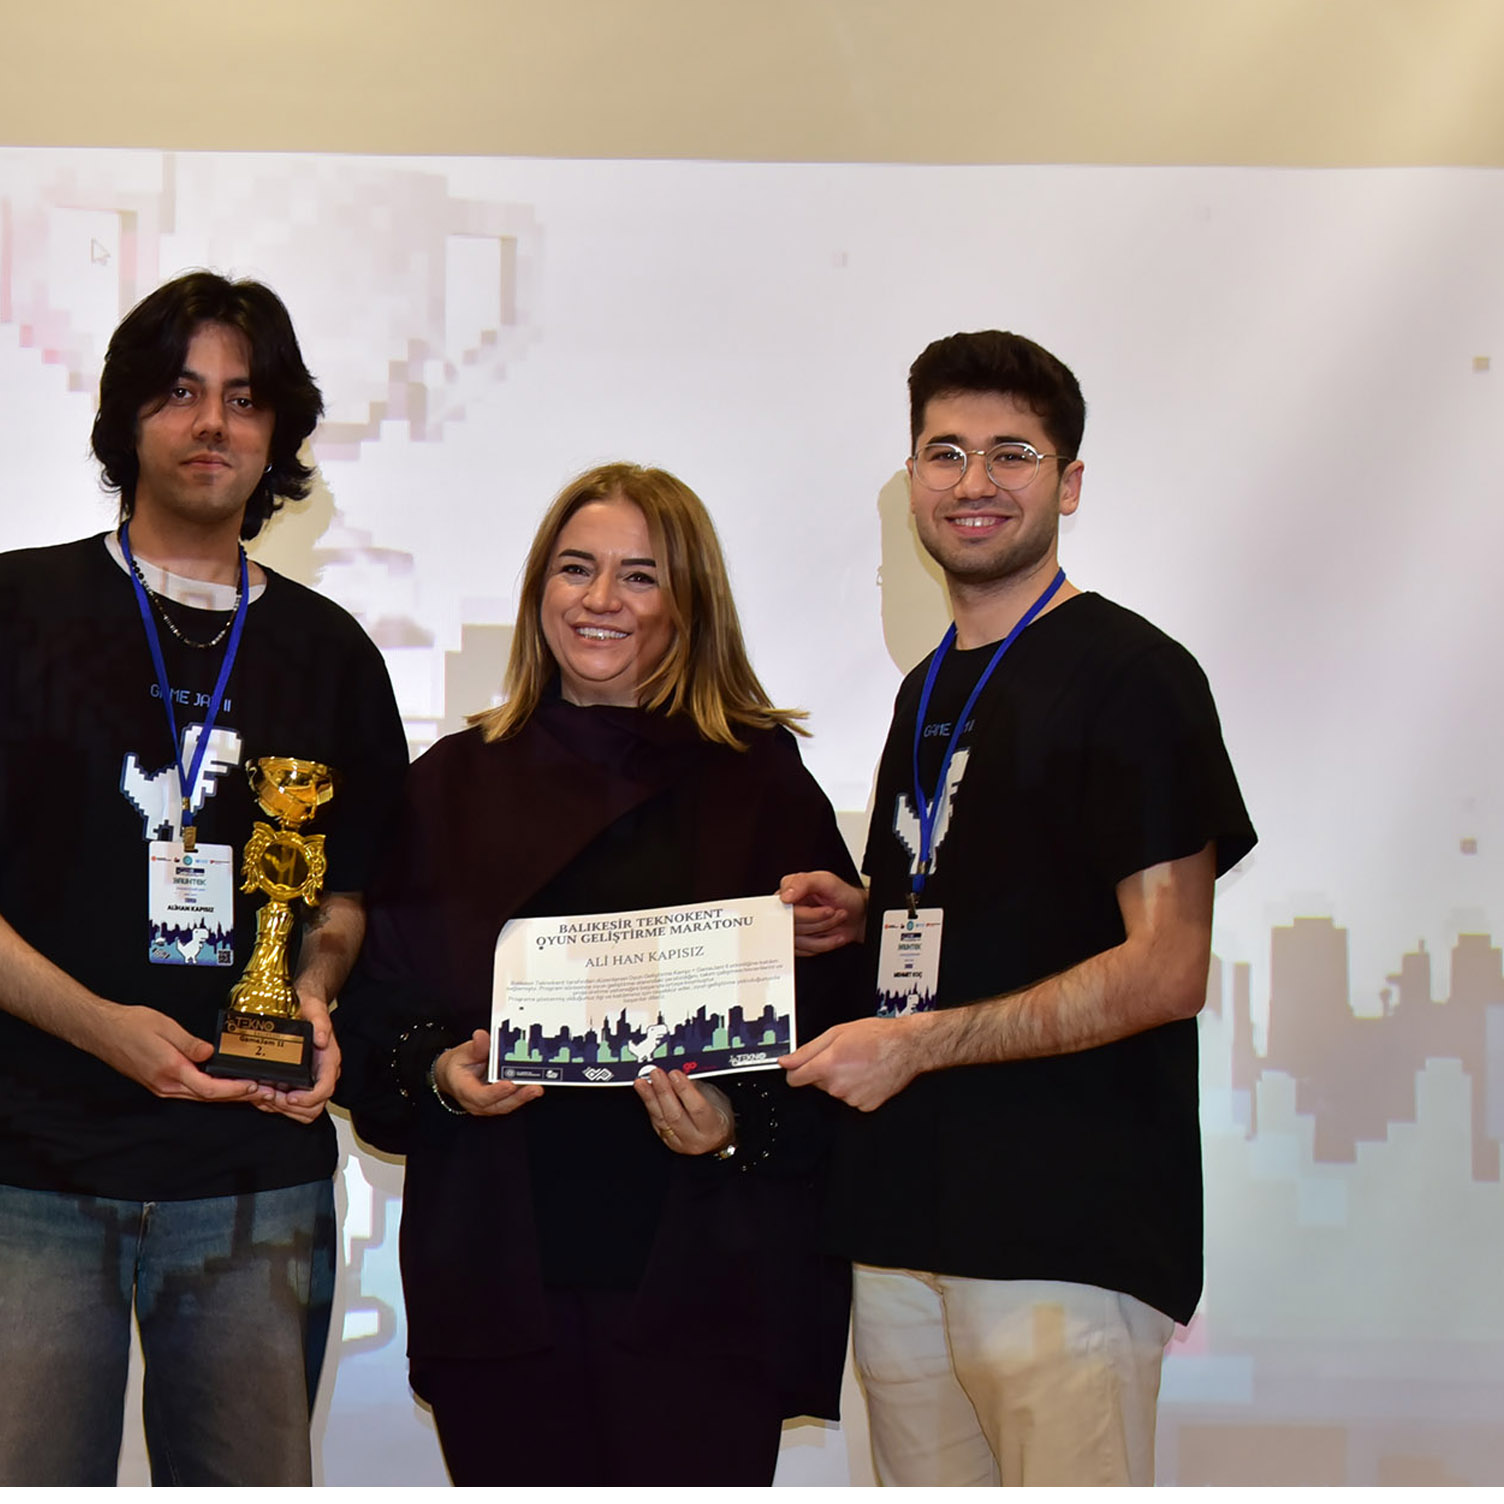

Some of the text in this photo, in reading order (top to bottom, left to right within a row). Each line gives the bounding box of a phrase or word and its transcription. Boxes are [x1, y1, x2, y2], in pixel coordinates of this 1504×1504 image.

[150, 684, 190, 704] GME
[558, 909, 722, 933] BALIKESİR TEKNOKENT
[535, 917, 753, 946] OYUN GELİŞTİRME MARATONU
[584, 946, 704, 967] ALİ HAN KAPISIZ
[236, 1016, 274, 1032] TEKNO
[255, 1046, 266, 1056] 2.
